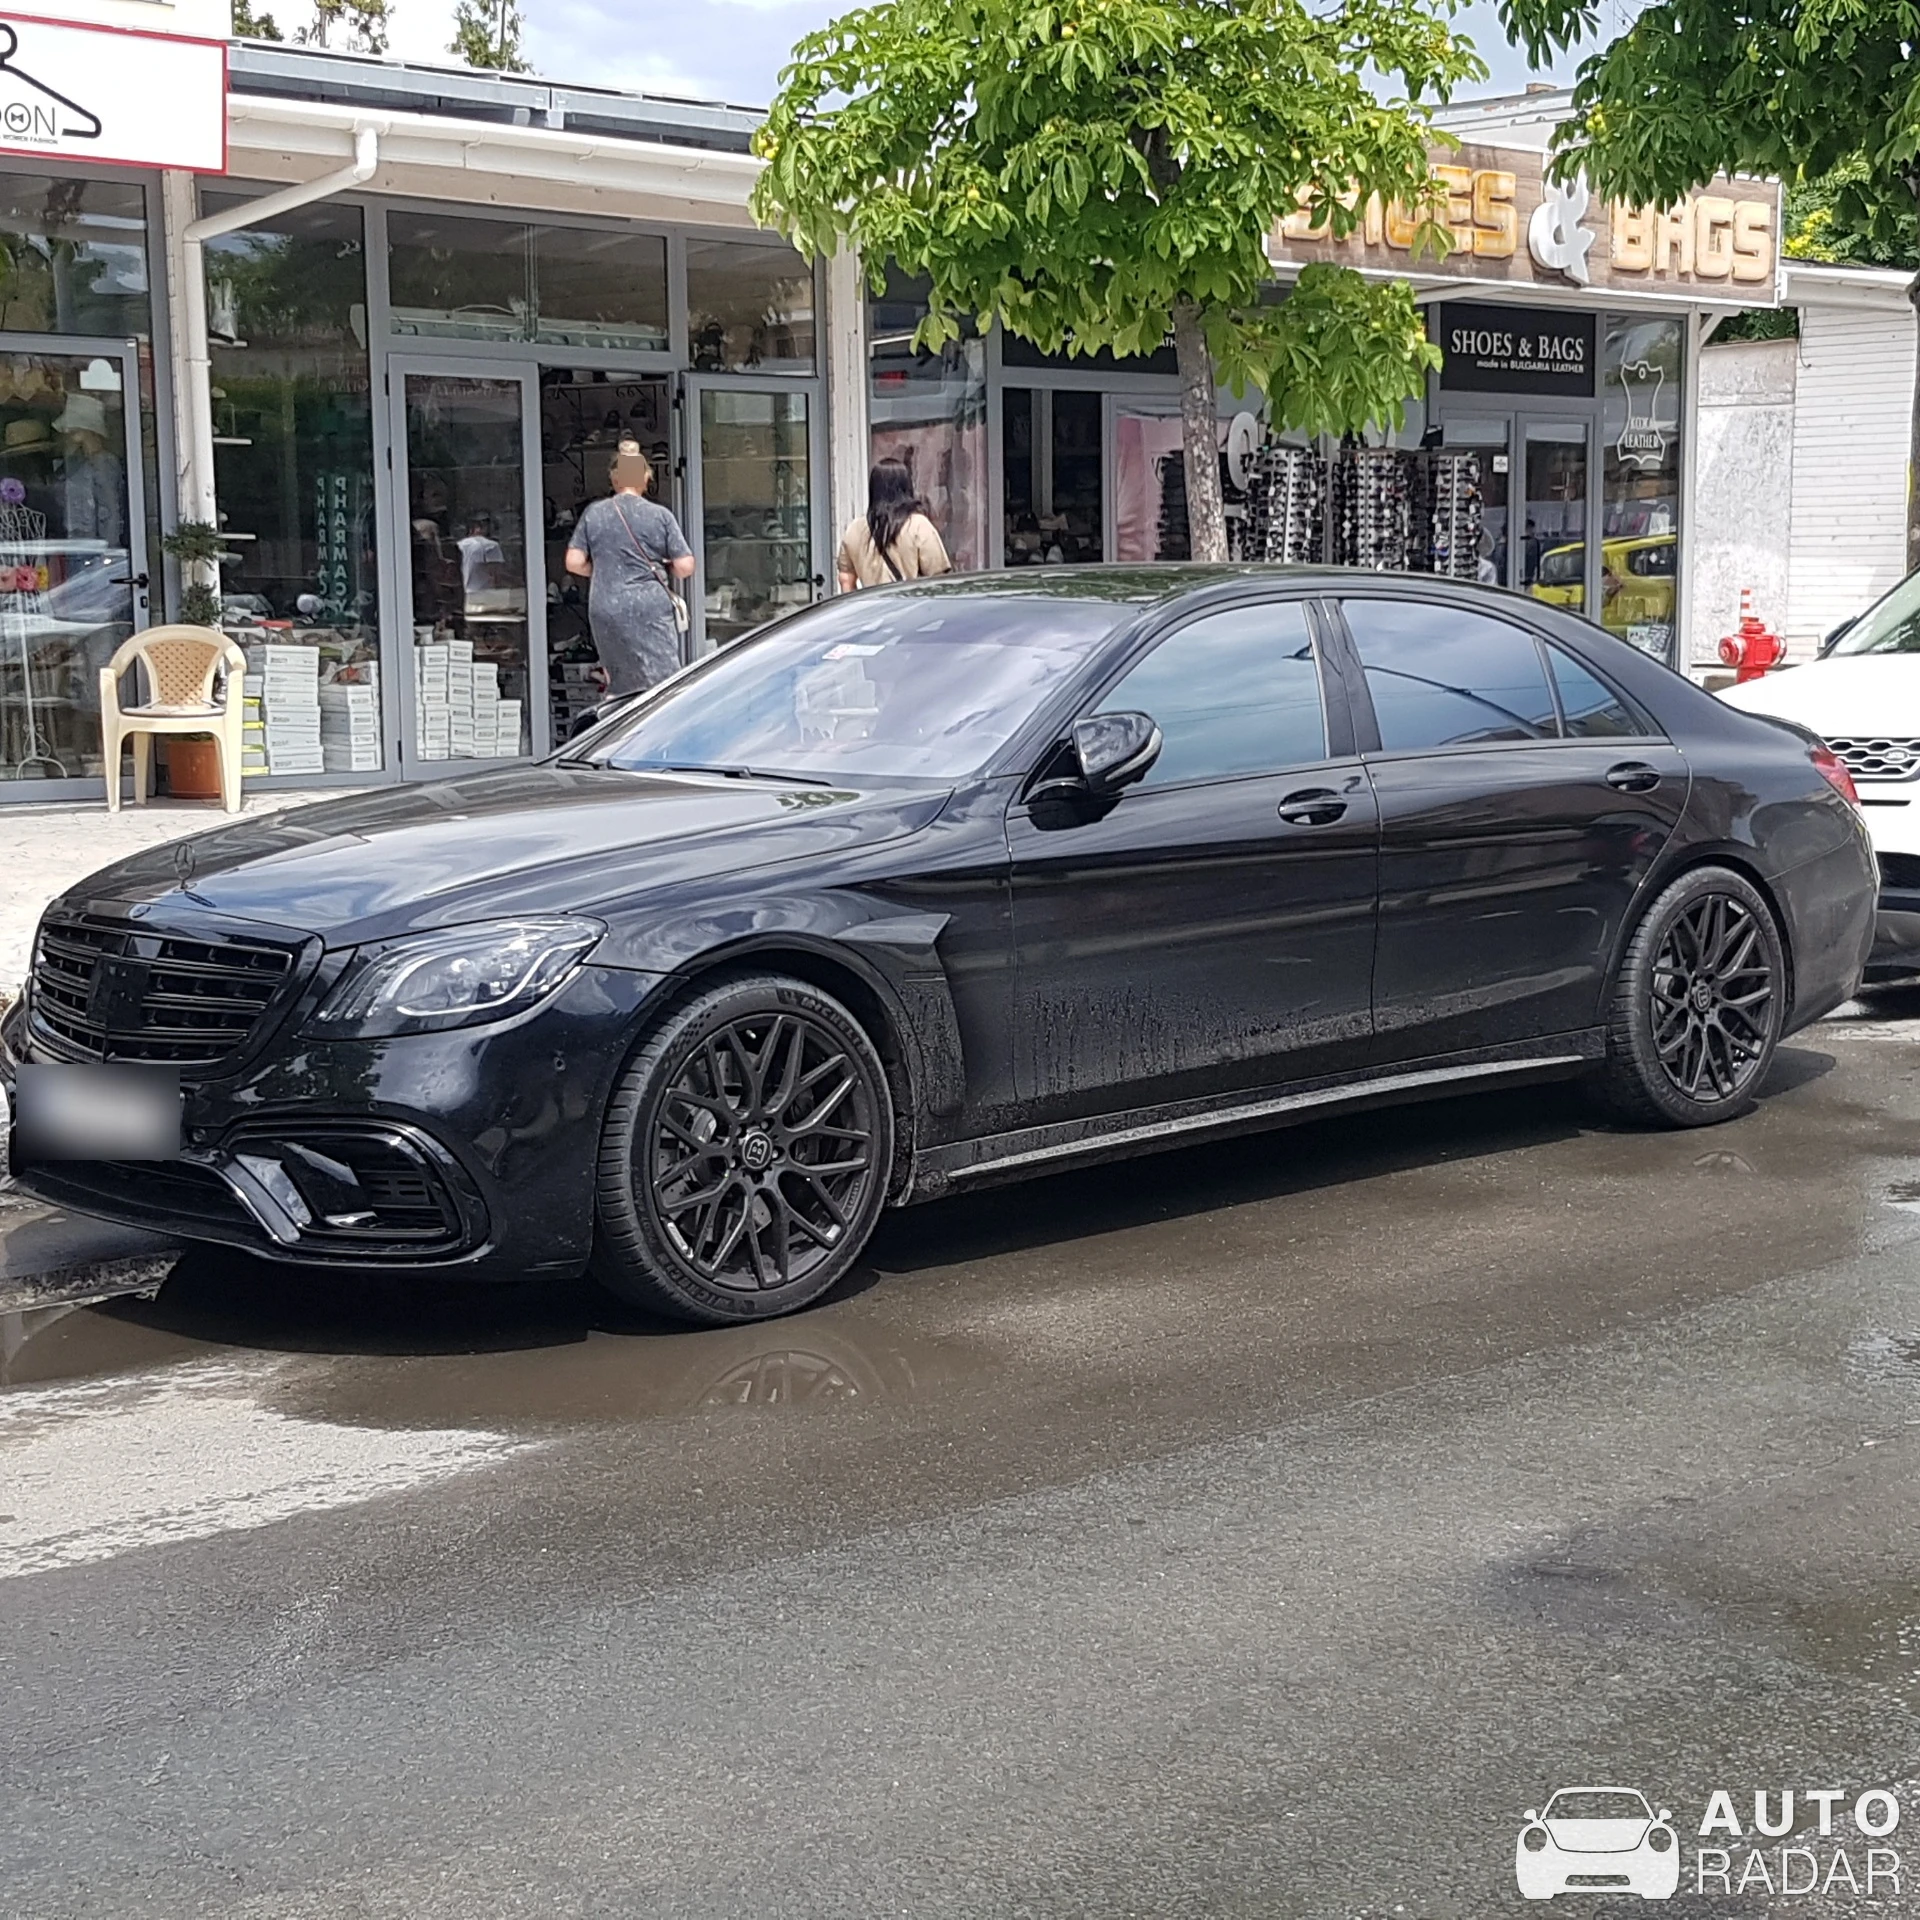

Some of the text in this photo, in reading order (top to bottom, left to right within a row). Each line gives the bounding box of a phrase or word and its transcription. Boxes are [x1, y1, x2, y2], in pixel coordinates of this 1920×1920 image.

[0, 102, 56, 137] ON
[1611, 193, 1771, 281] BAGS
[1451, 329, 1584, 361] SHOES & BAGS
[1510, 361, 1550, 372] BULGARIA
[1552, 364, 1584, 374] LEATHER
[1625, 434, 1659, 449] LEATHER
